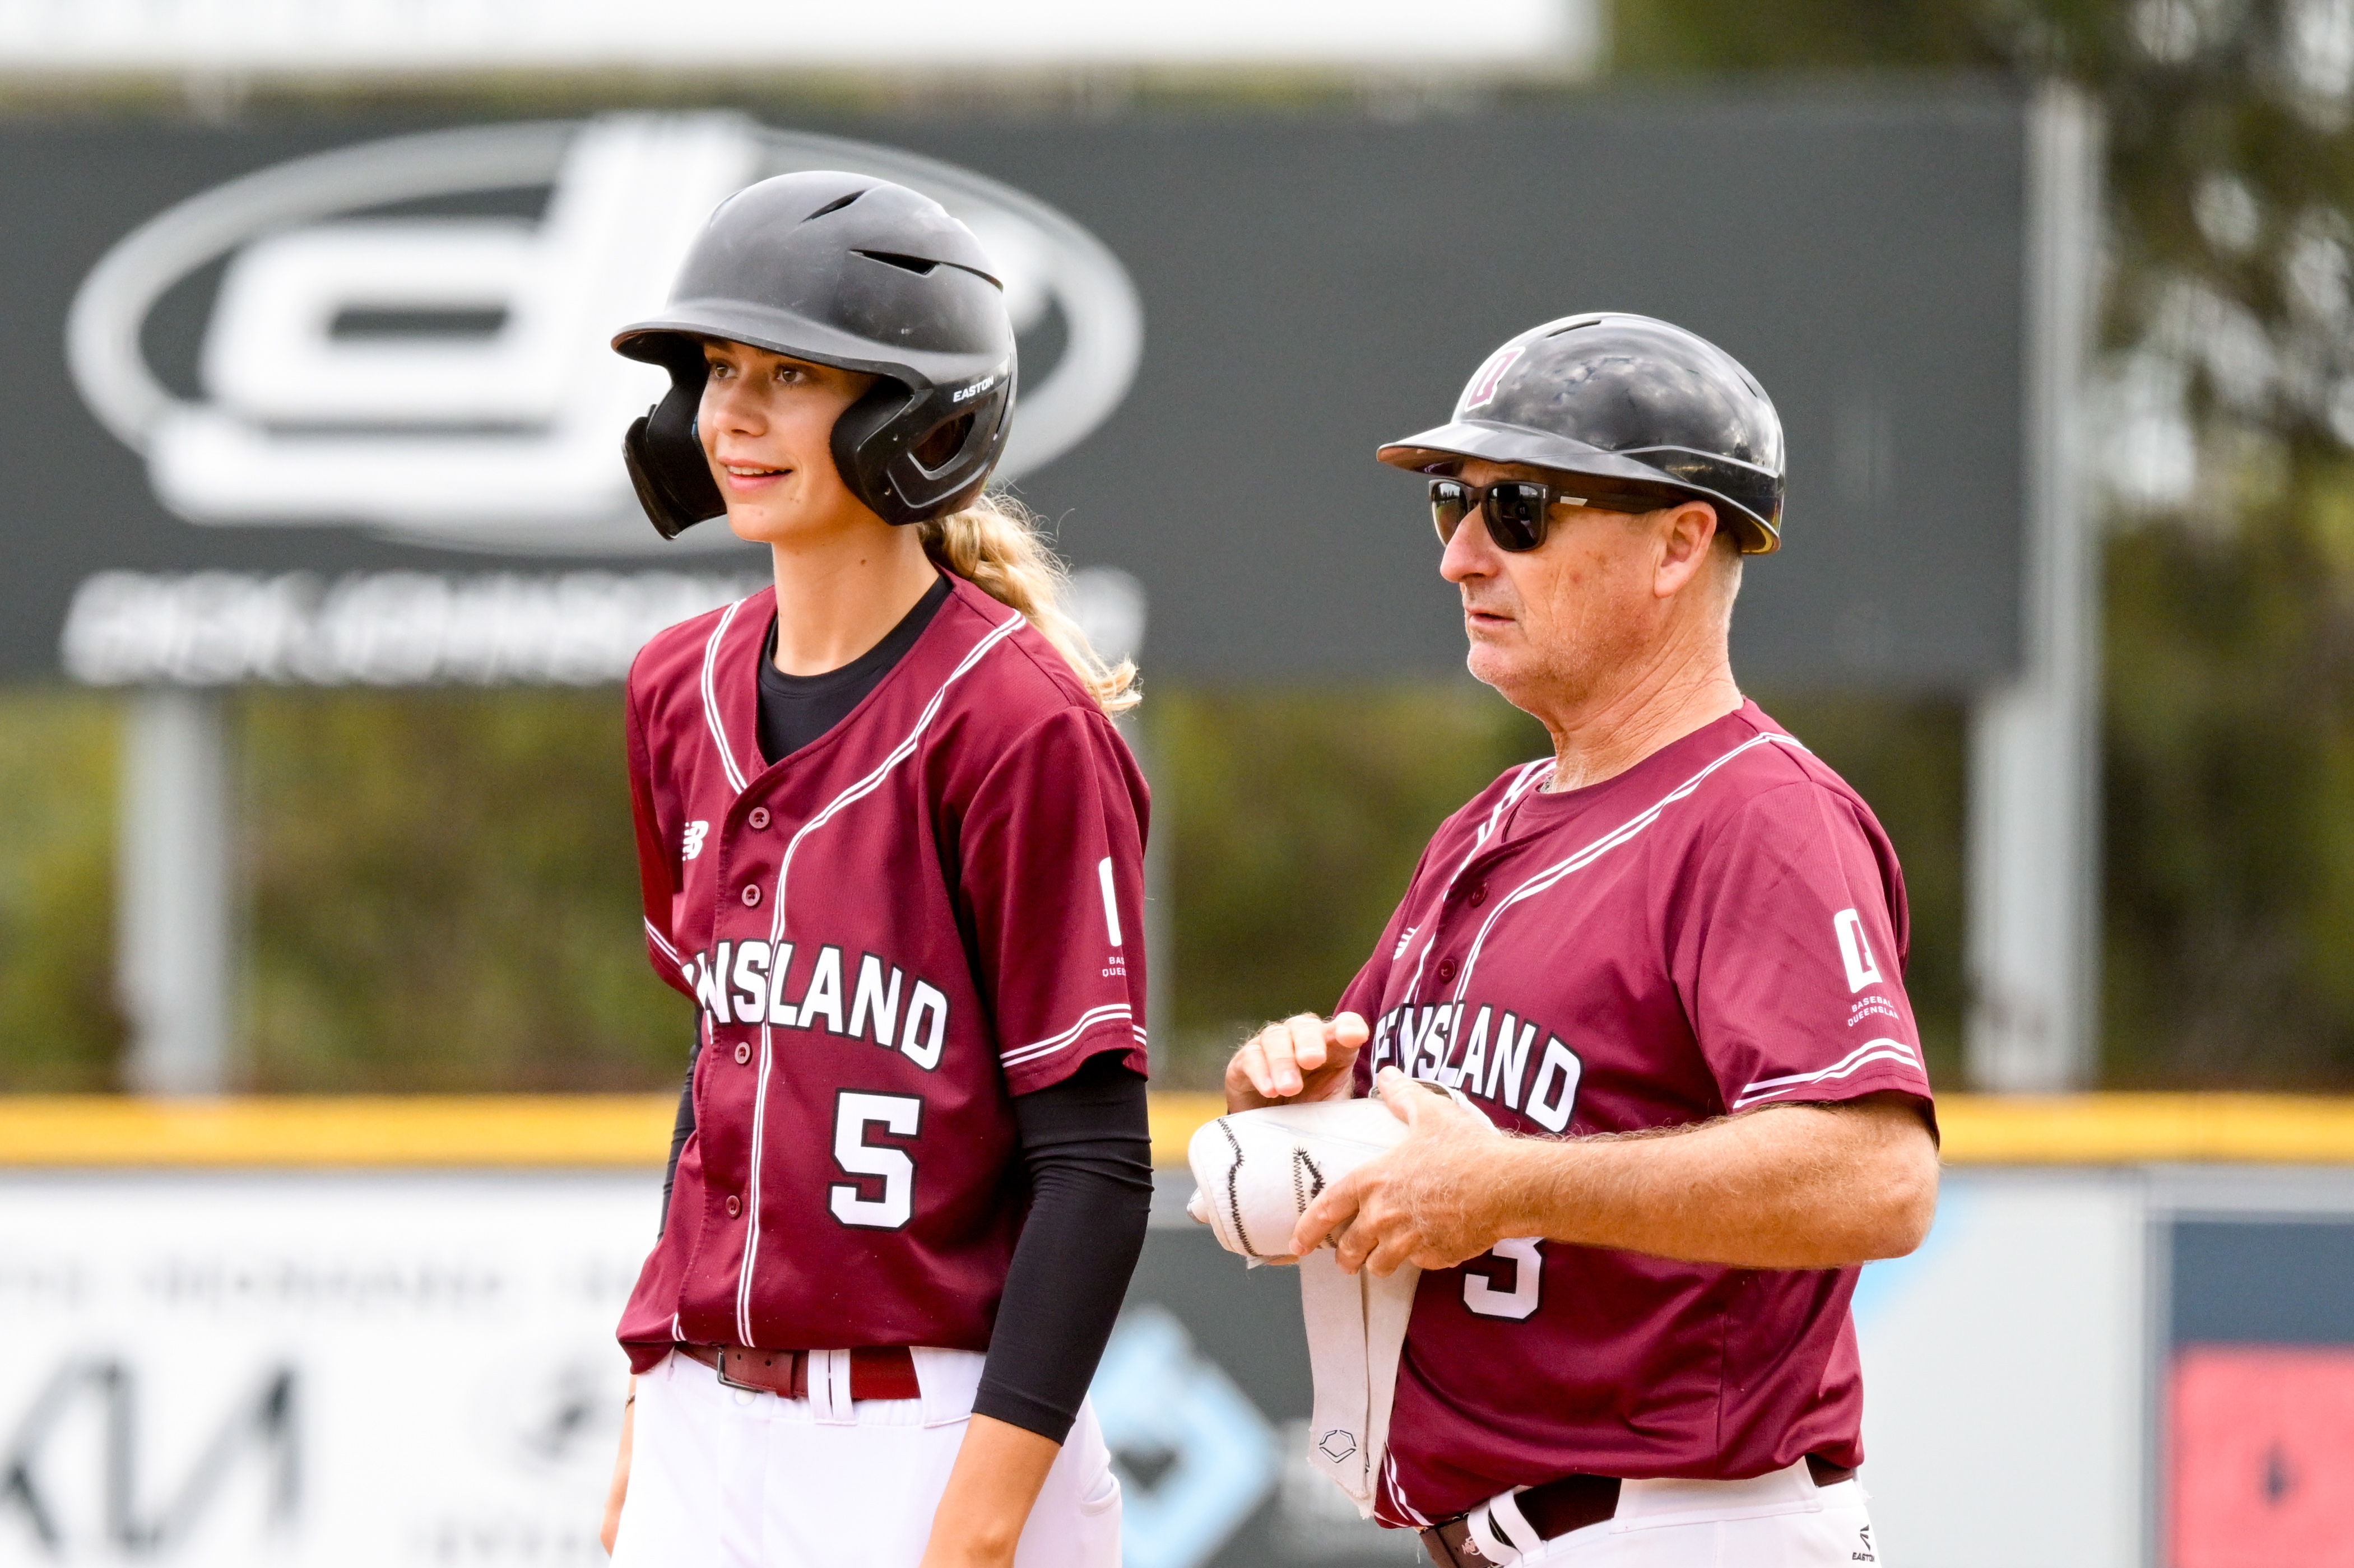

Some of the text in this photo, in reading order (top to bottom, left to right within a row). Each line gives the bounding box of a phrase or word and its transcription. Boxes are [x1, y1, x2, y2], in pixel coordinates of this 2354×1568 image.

[953, 375, 993, 402] EASTON
[1851, 996, 1894, 1013] BASEBAL
[1371, 1000, 1584, 1134] ENSLAND
[827, 1088, 925, 1231] 5
[1460, 1237, 1547, 1323] 3
